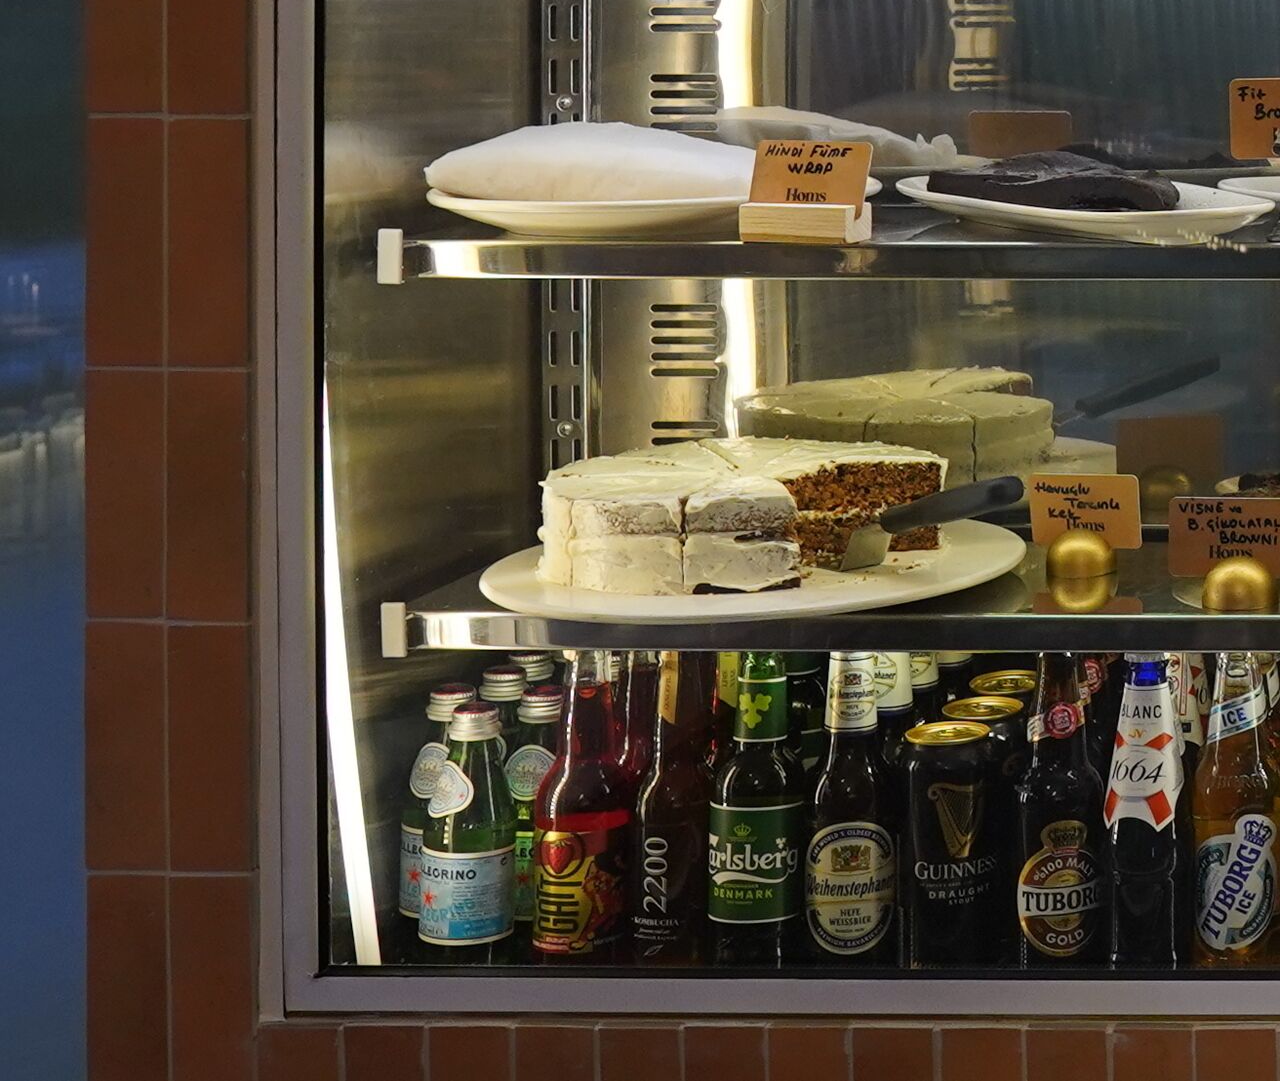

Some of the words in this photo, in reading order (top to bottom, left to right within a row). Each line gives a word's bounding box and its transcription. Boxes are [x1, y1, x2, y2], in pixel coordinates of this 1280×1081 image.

[1237, 86, 1266, 101] Fit
[788, 161, 833, 175] WRAP
[786, 187, 827, 202] Homs
[1208, 545, 1254, 560] Homs
[1121, 705, 1163, 719] BLANC
[1221, 707, 1247, 727] ICE
[1111, 758, 1167, 784] 1664
[642, 836, 669, 914] 2200
[914, 855, 999, 880] GUINNESS
[1066, 857, 1096, 877] MALT
[713, 887, 774, 899] DENMARK
[928, 882, 991, 900] DRAUGHT
[1200, 842, 1263, 940] TUBORG
[1235, 890, 1257, 915] ICE
[1046, 928, 1085, 945] GOLD
